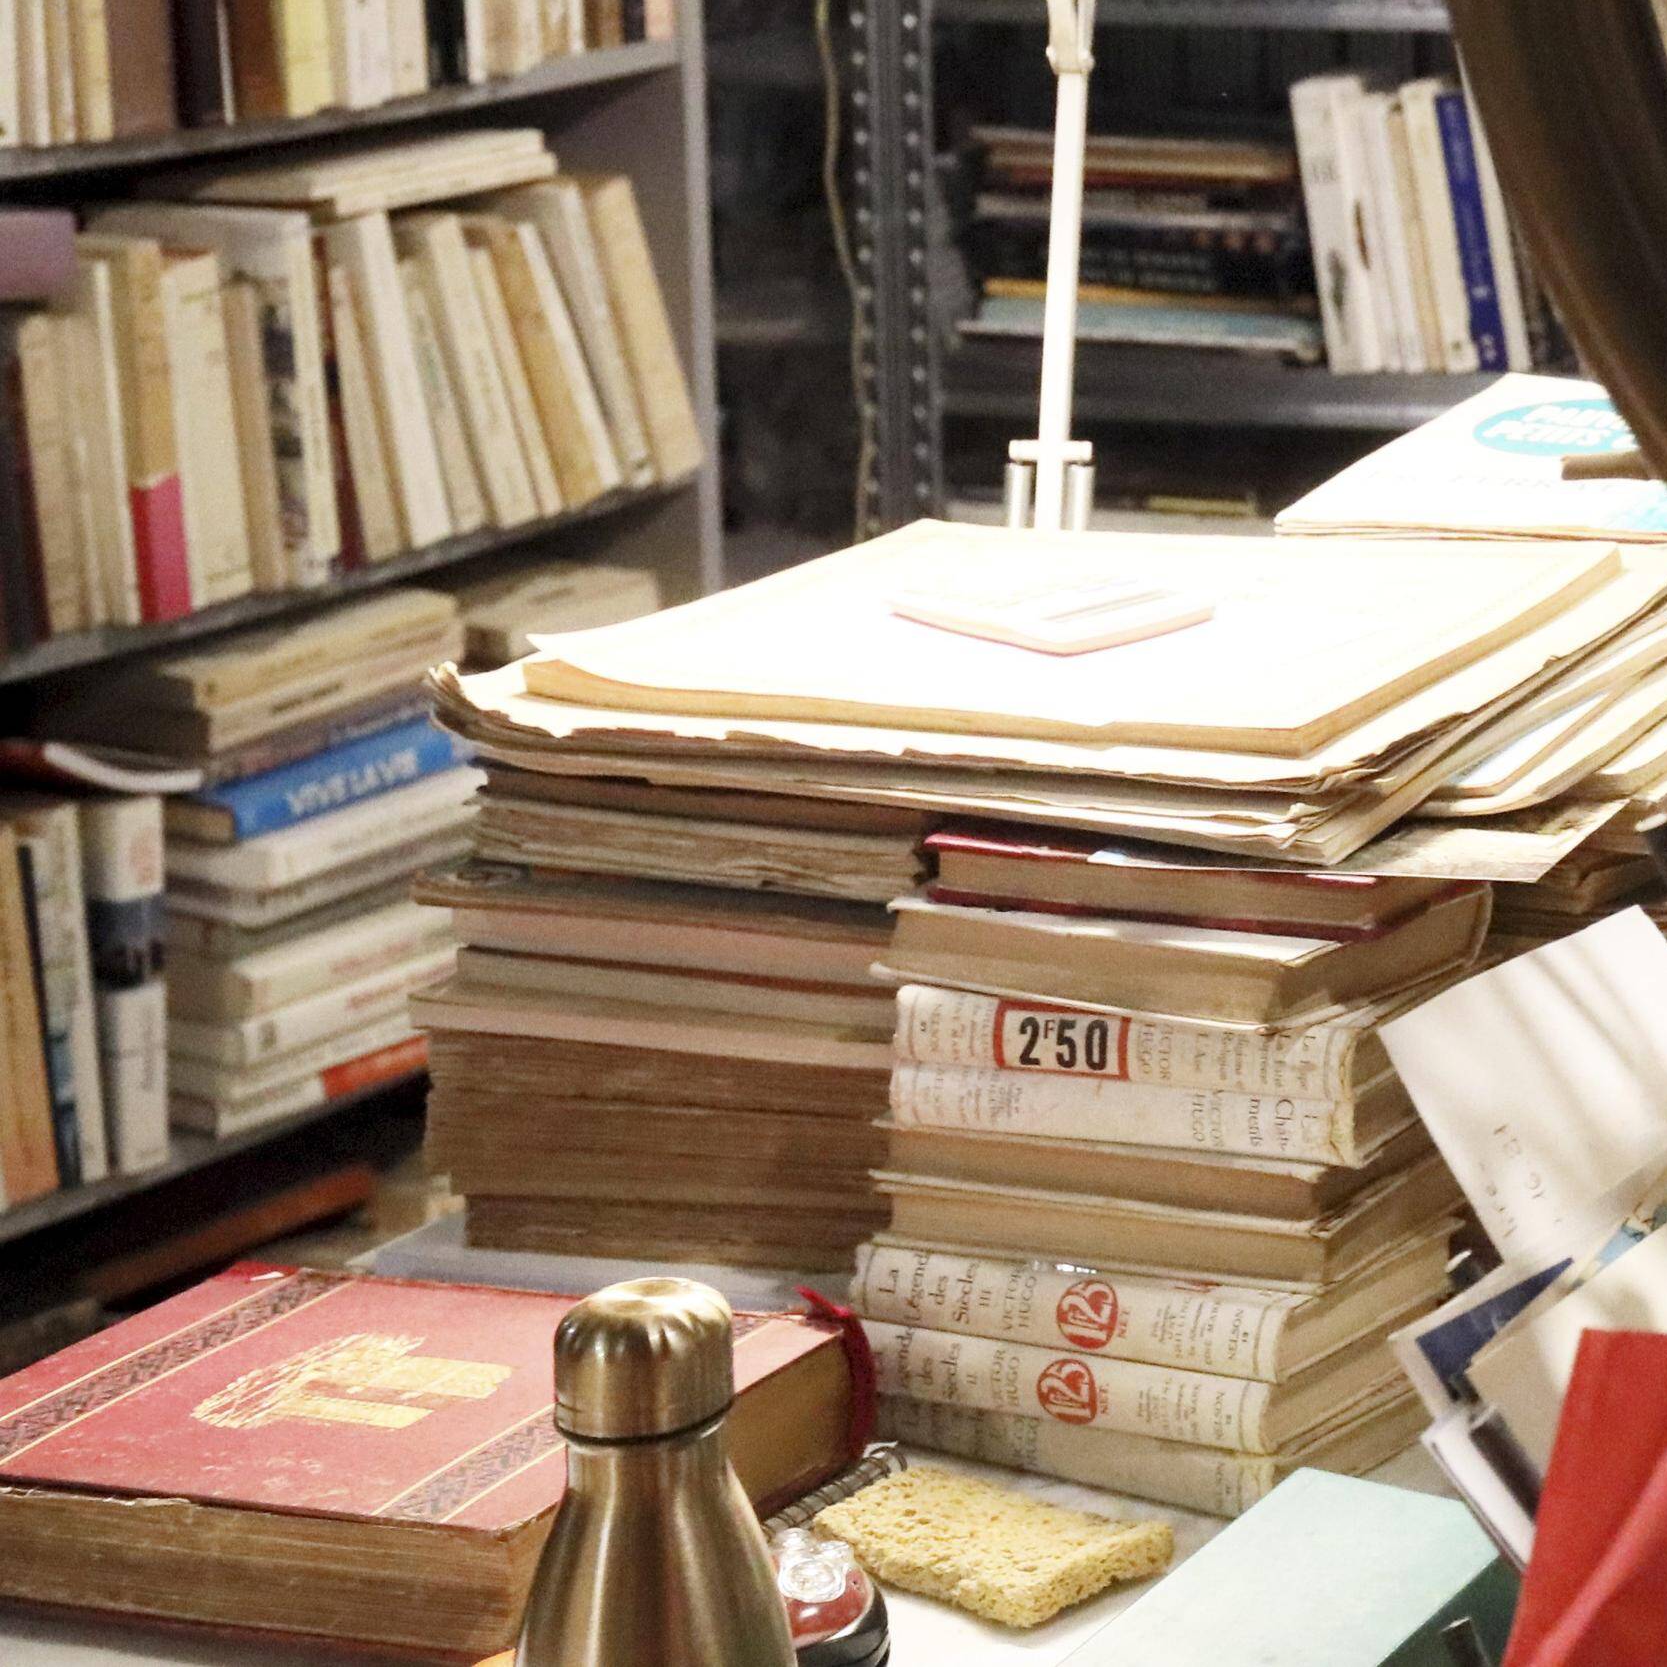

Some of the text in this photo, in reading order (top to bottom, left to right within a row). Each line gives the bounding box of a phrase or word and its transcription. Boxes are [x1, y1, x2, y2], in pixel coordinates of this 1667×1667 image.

[878, 1267, 901, 1296] La
[927, 1274, 950, 1307] des
[1018, 1275, 1038, 1329] HUGO
[1227, 1308, 1245, 1360] NELSON
